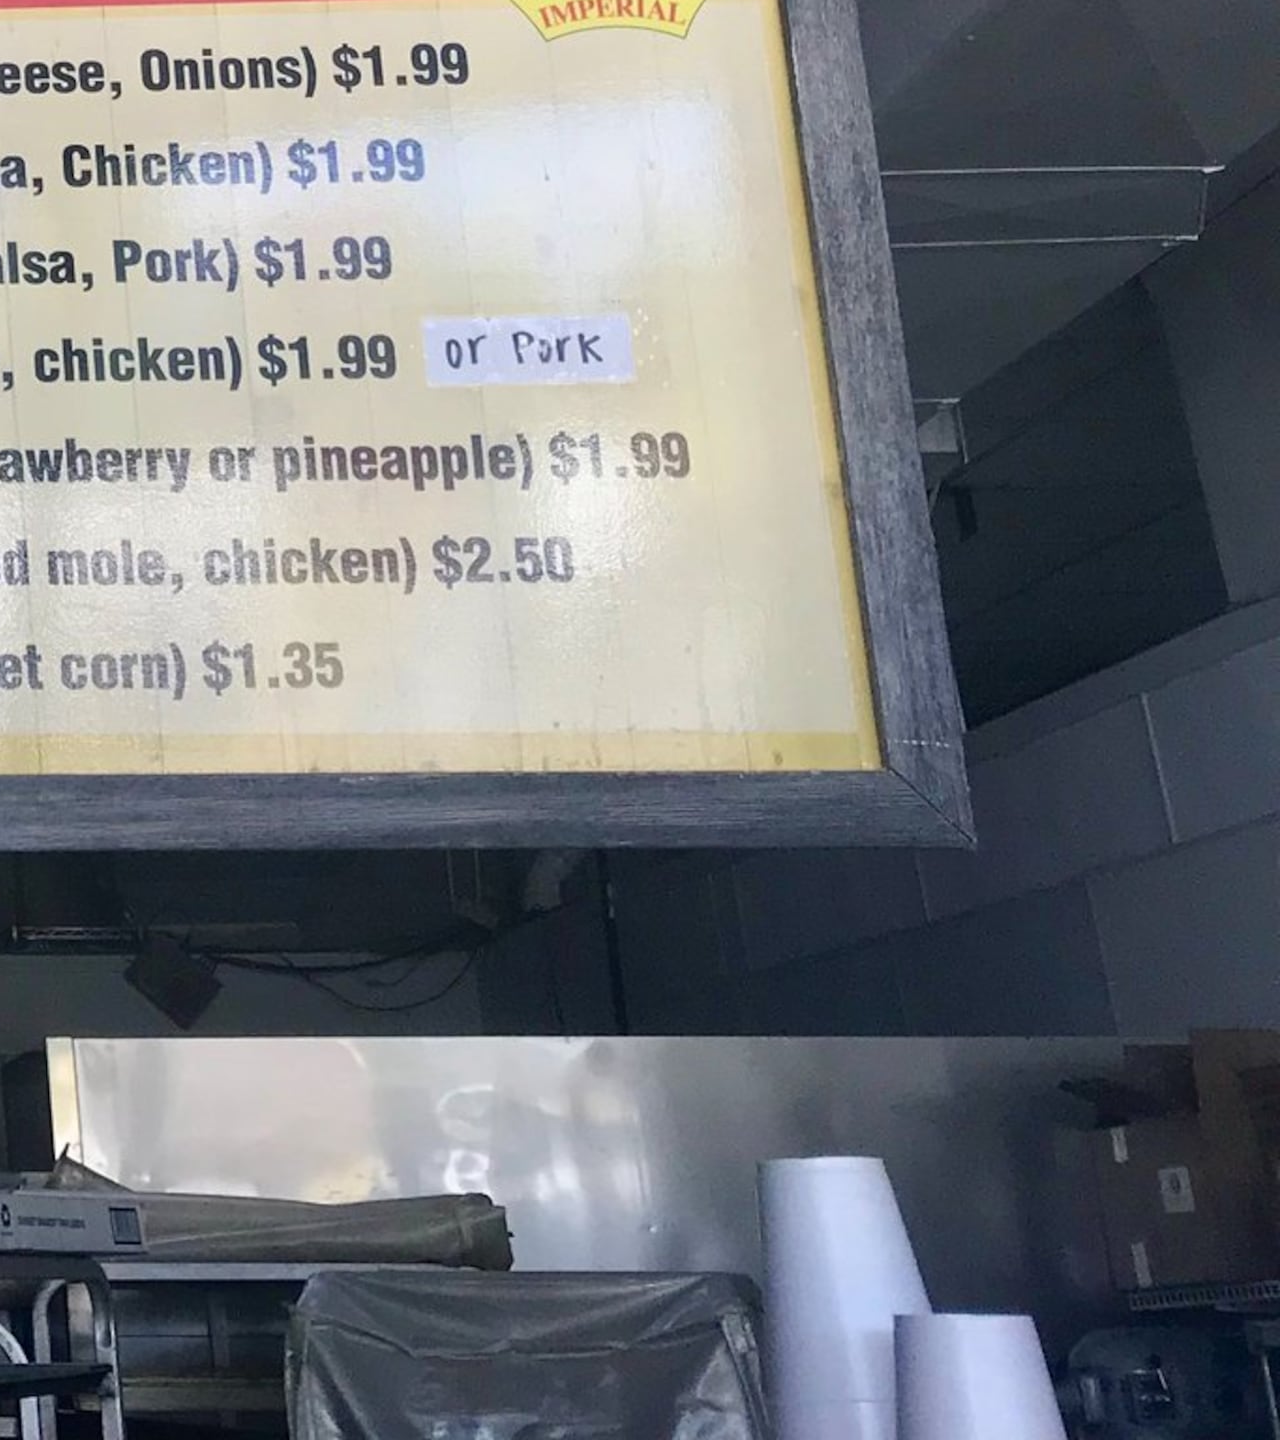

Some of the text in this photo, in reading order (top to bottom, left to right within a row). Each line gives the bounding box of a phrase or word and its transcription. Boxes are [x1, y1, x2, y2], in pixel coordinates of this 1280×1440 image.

[140, 46, 317, 98] Onions)
[332, 43, 469, 93] $1.99
[62, 142, 272, 193] Chicken)
[288, 139, 424, 189] $1.99
[113, 239, 239, 292] Pork)
[255, 236, 392, 287] $1.99
[34, 336, 242, 391] chicken)
[258, 334, 396, 387] $1.99
[445, 332, 489, 368] or
[210, 447, 255, 481] or
[273, 434, 532, 492] pineapple)
[550, 432, 689, 477] $1.99
[47, 540, 183, 593] mole,
[205, 538, 416, 594] chicken)
[433, 535, 573, 589] $2.50
[61, 643, 186, 700] corn)
[202, 641, 343, 696] $1.35
